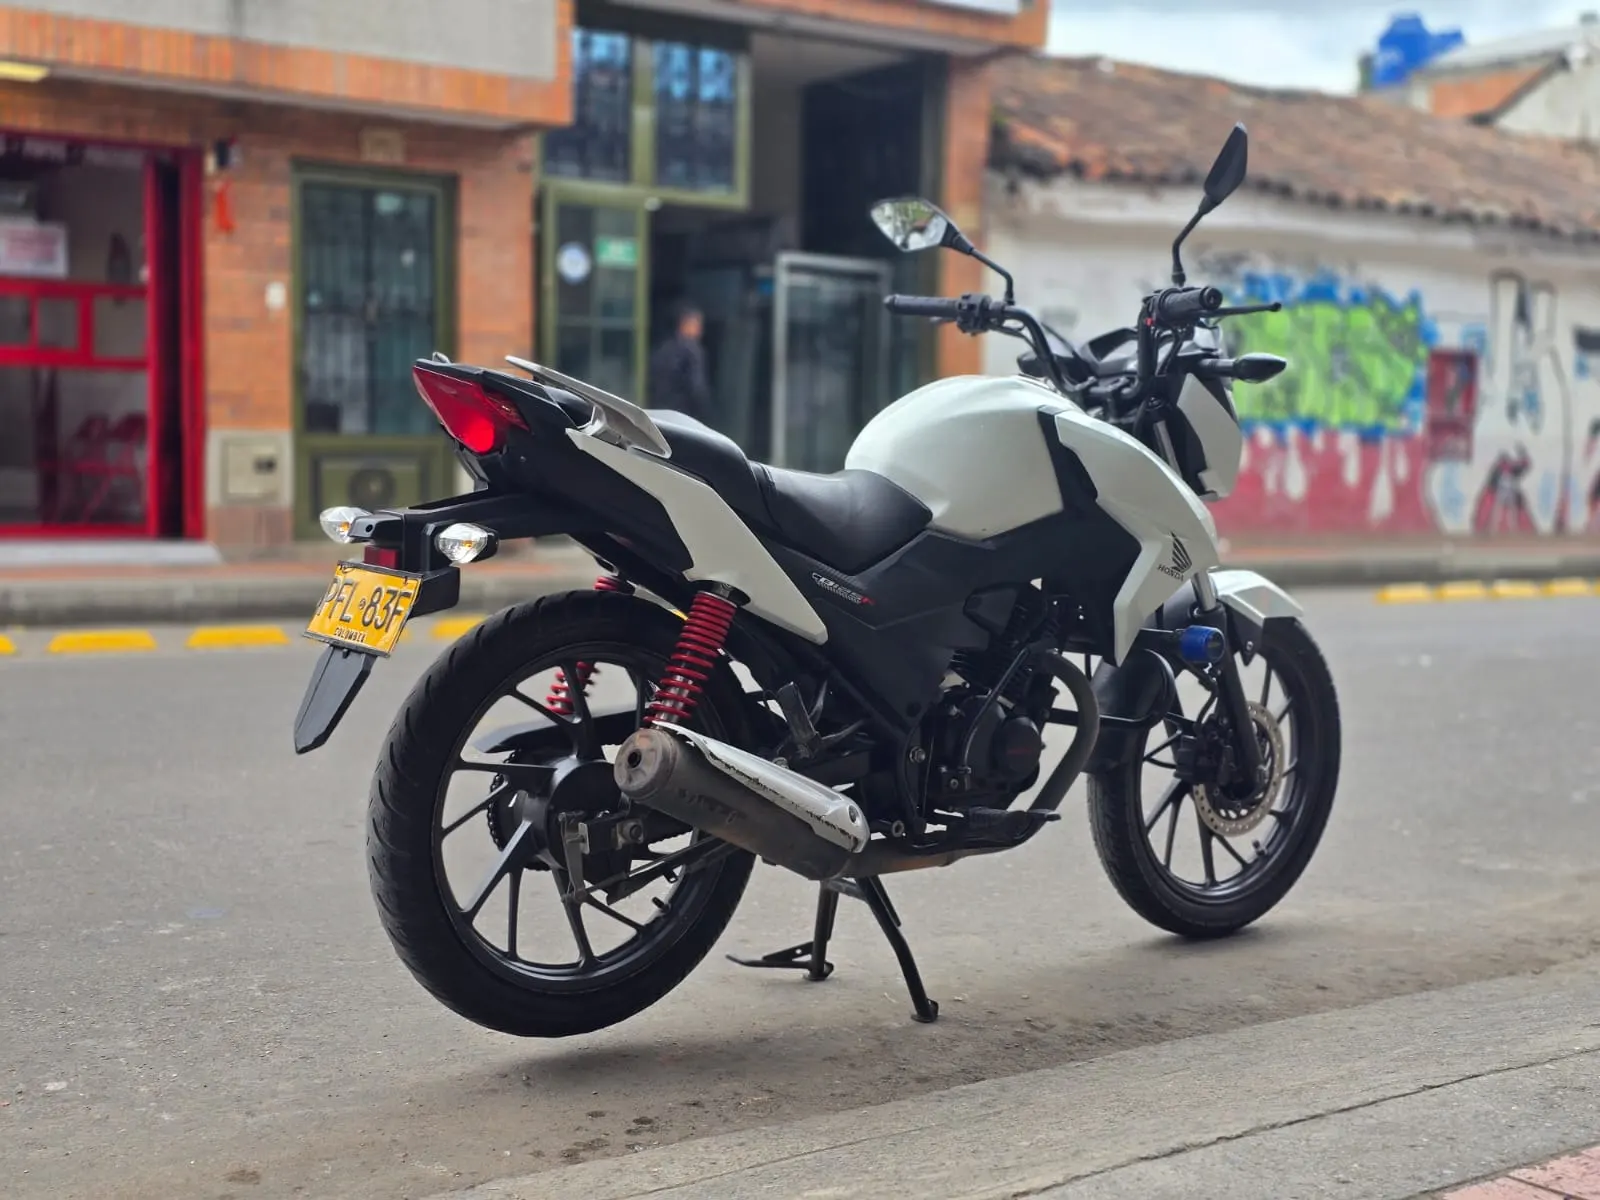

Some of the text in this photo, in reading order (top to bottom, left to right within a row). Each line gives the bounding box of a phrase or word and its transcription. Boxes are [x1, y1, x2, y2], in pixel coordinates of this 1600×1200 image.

[317, 577, 412, 633] PFL 83F
[334, 627, 366, 643] COLOMBIA
